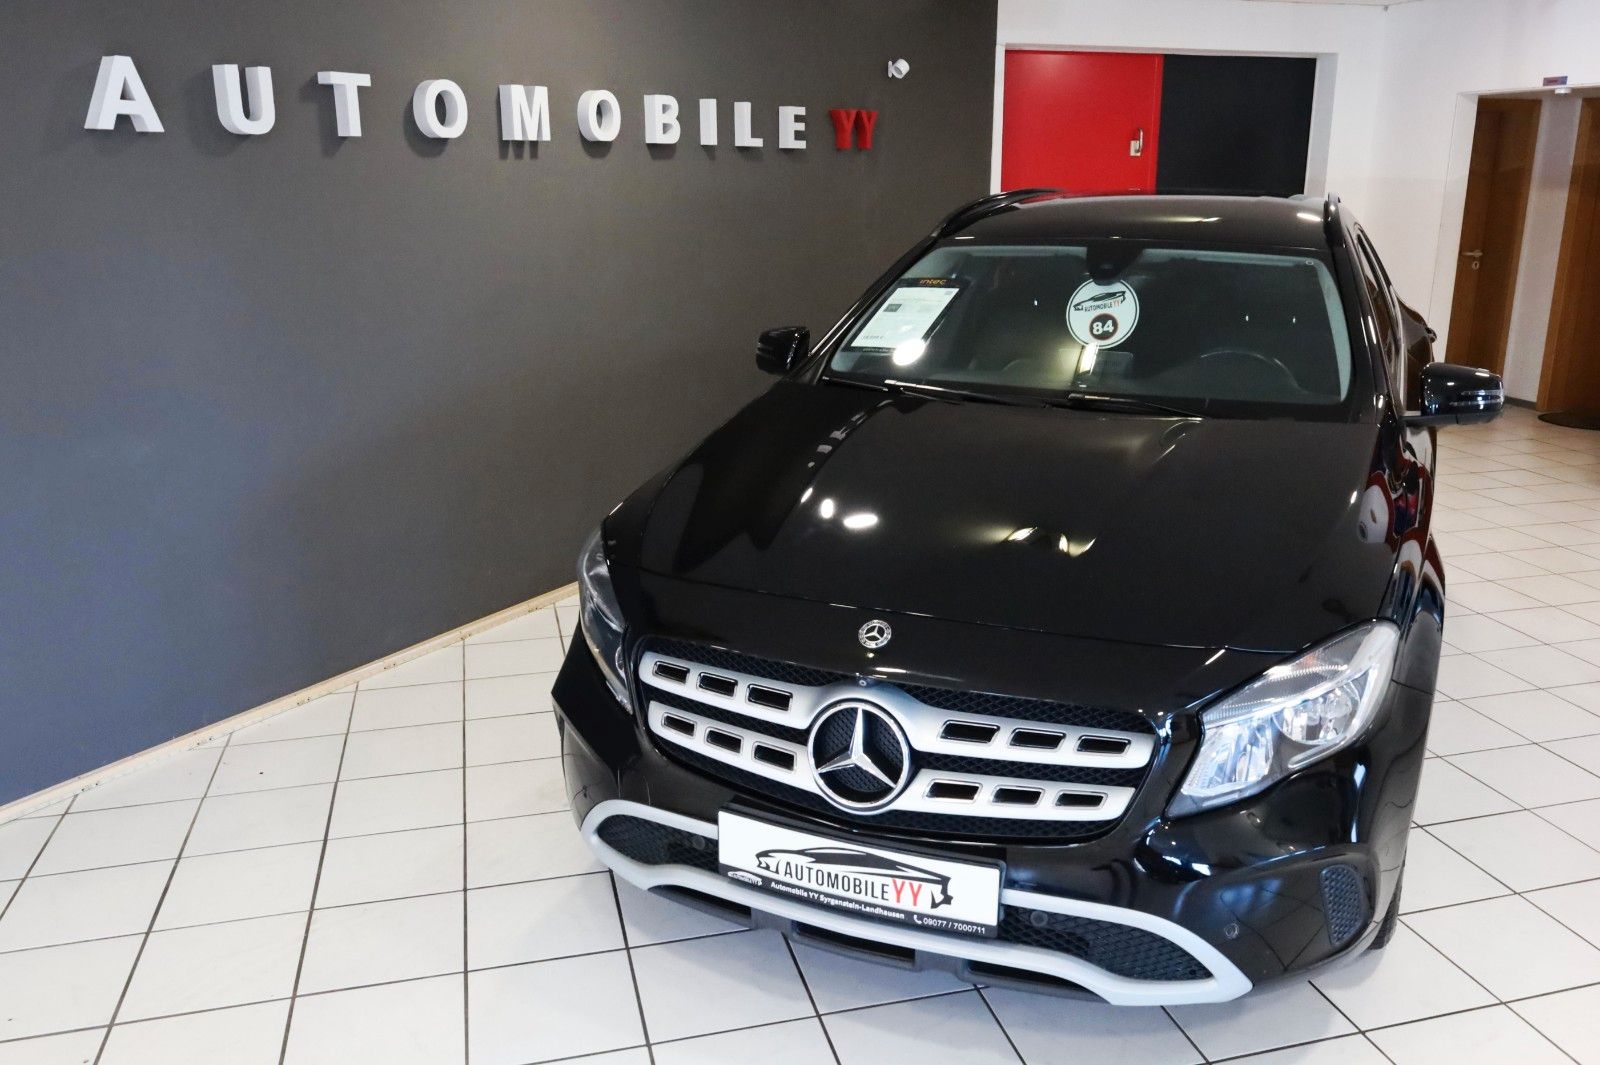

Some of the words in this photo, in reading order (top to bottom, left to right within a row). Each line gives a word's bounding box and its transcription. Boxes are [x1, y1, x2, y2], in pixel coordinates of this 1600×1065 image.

[84, 55, 806, 149] AUTOMOBILE
[829, 107, 879, 150] YY
[1092, 319, 1115, 336] 84
[771, 881, 808, 898] Automobile
[808, 891, 819, 900] YY
[819, 894, 905, 920] Syrgenstein-Landhausen
[923, 916, 947, 929] 09077
[953, 922, 986, 935] 7000711
